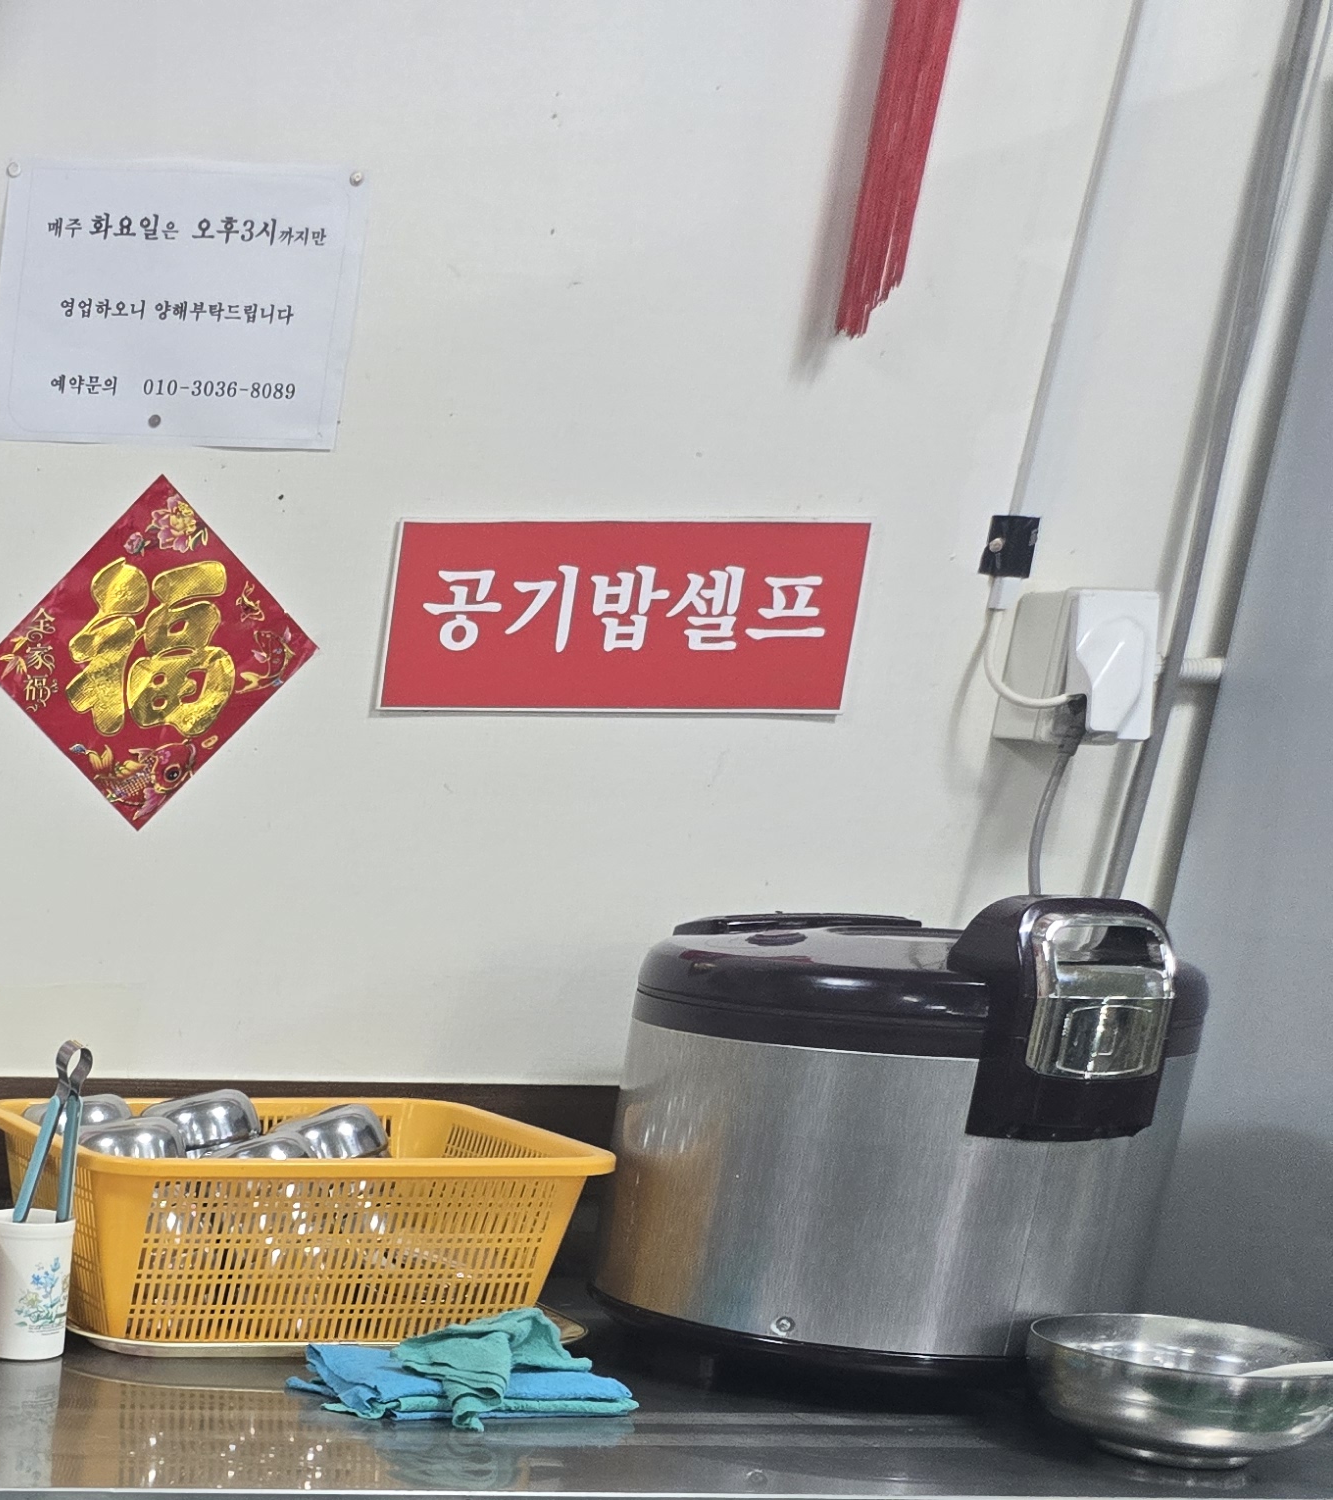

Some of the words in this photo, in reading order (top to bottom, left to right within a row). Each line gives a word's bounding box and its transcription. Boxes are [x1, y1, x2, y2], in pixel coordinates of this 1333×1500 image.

[47, 217, 83, 238] 매주
[89, 212, 179, 241] 화요일은
[192, 216, 327, 247] 오후3시까지만
[60, 297, 146, 320] 영업하오니
[154, 300, 295, 326] 양해부탁드립니다
[50, 374, 119, 396] 예약문의
[143, 378, 296, 401] 010-3036-8089
[422, 565, 828, 654] 공기밥셀프
[23, 607, 58, 712] 全家福
[65, 557, 236, 737] 福
